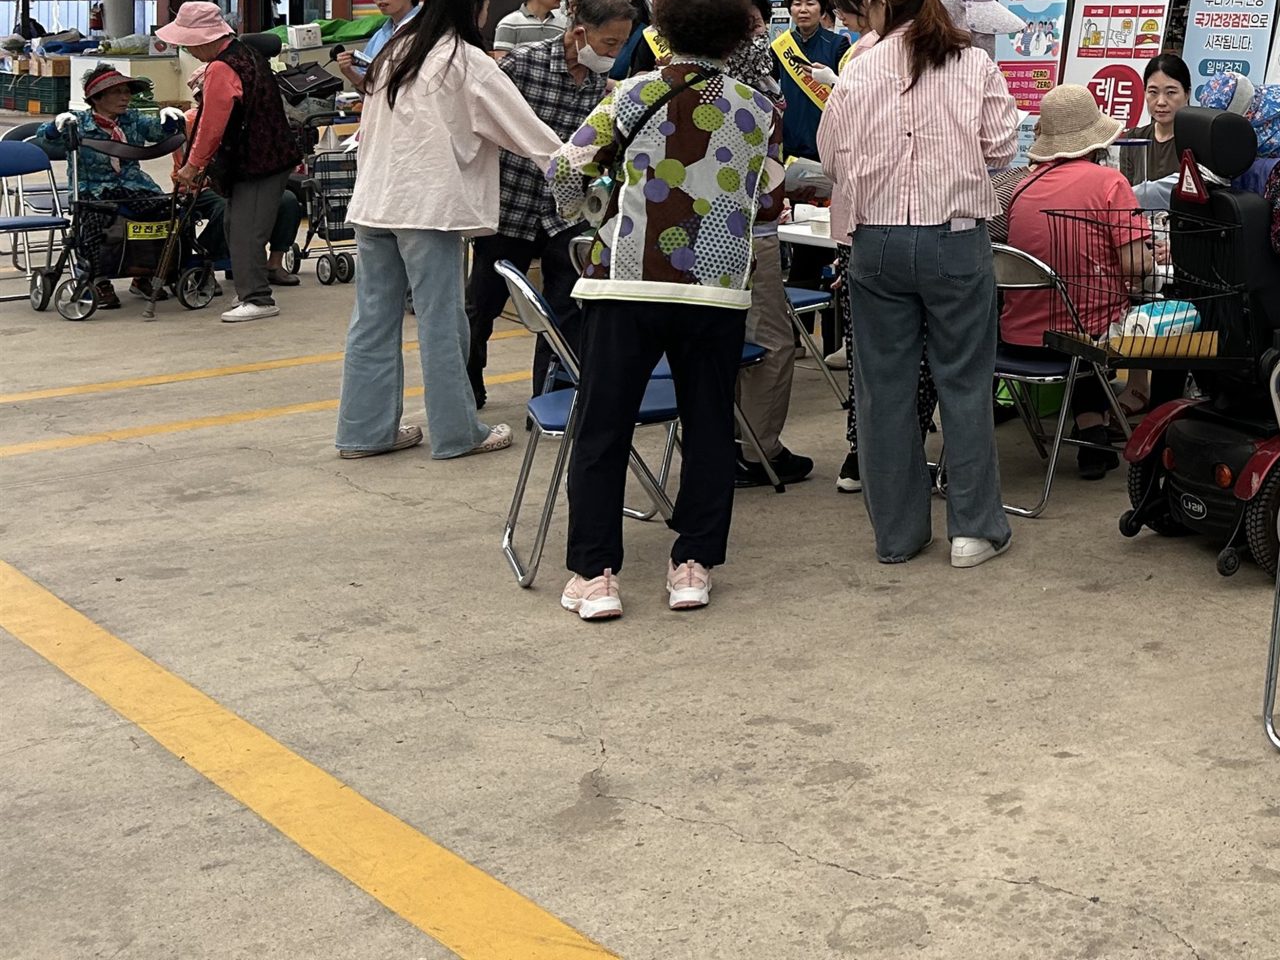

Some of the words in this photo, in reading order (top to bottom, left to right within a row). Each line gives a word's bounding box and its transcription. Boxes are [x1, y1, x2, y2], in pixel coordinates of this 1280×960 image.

[1195, 12, 1269, 28] 국가건강검진으로
[1205, 35, 1253, 51] 시작됩니다.
[1032, 70, 1048, 78] ZERO
[1037, 81, 1051, 89] ZERO
[1091, 77, 1133, 103] 레드
